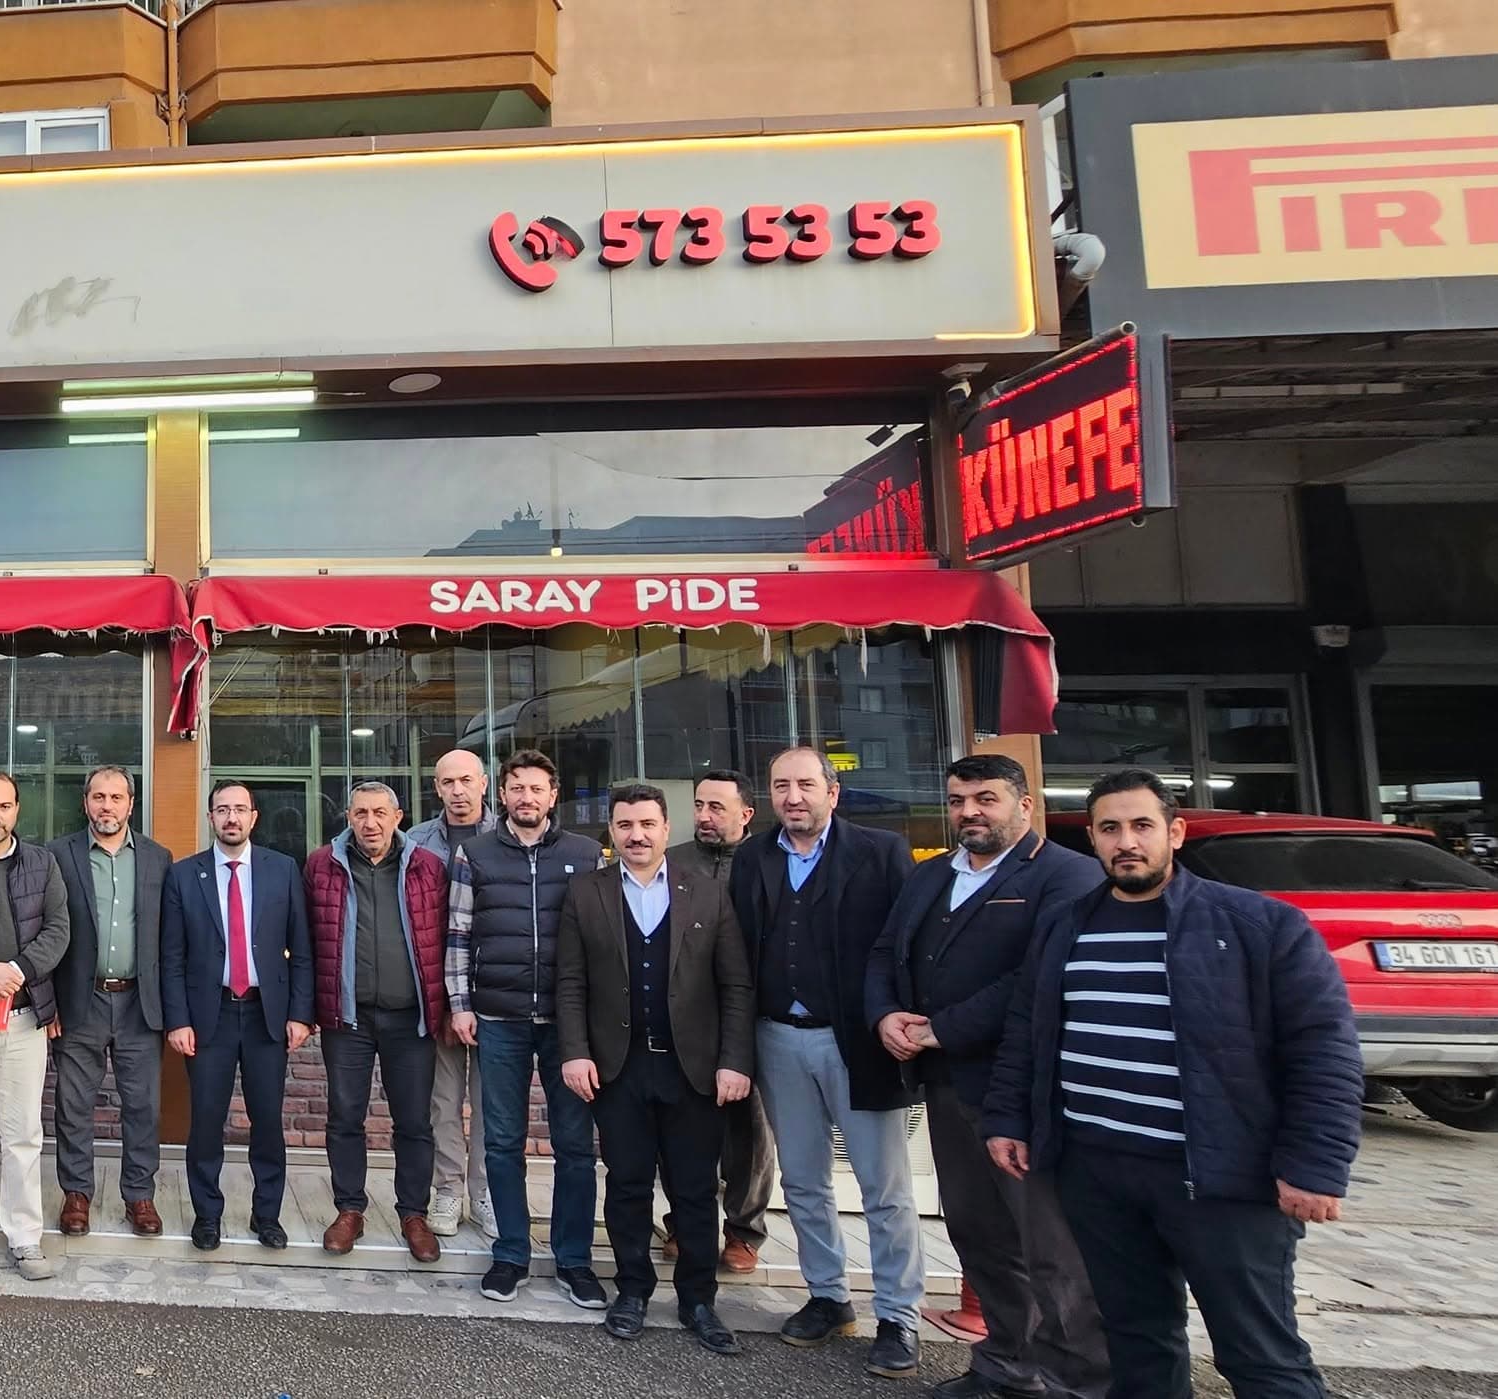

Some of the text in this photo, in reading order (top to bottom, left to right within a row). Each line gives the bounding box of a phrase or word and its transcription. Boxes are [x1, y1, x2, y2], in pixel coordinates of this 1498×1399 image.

[599, 200, 941, 266] 573 53 53
[961, 388, 1138, 537] KÜNEFE
[429, 579, 601, 613] SARAY
[1390, 945, 1415, 964] 34
